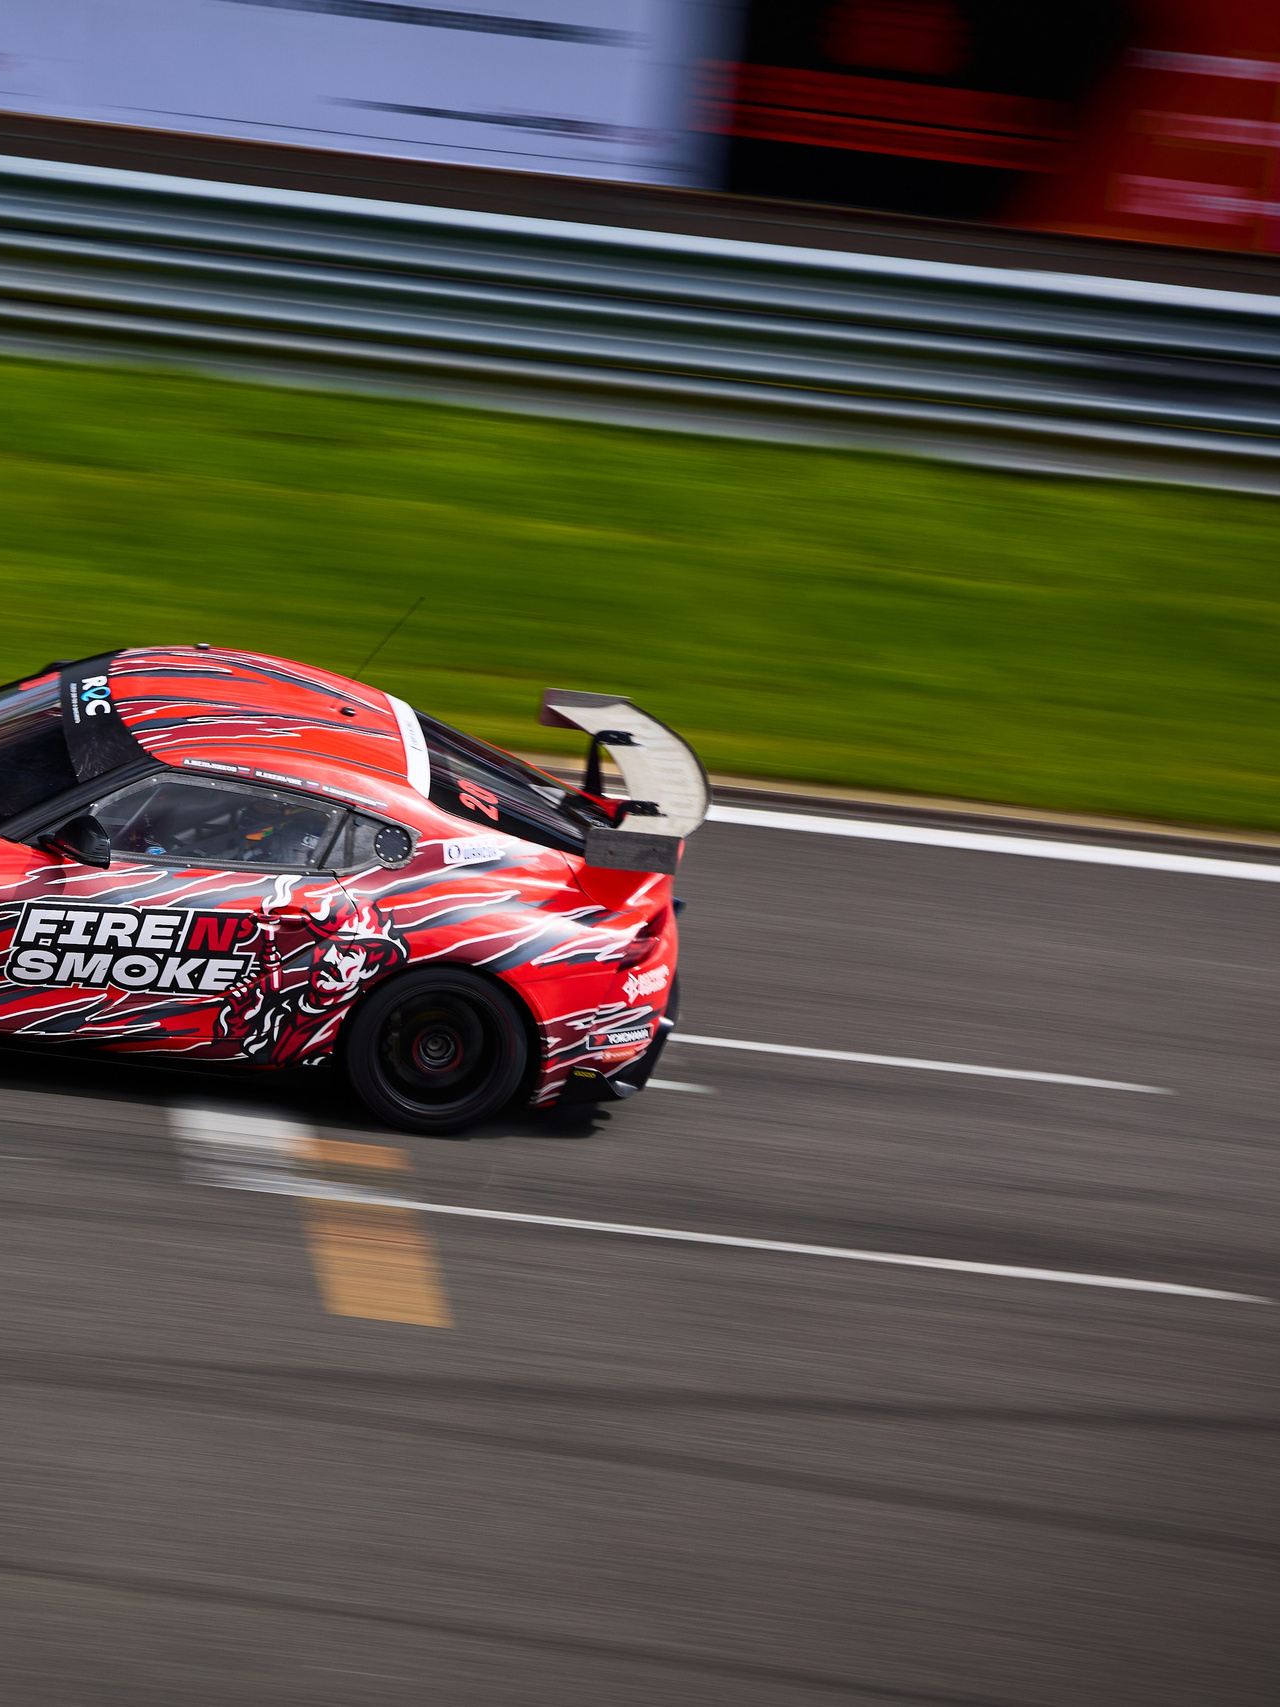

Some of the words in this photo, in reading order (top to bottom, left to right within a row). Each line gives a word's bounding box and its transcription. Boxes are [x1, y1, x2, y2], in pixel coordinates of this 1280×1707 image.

[457, 779, 499, 822] 20
[20, 907, 183, 951] FIRE
[11, 949, 245, 992] SMOKE
